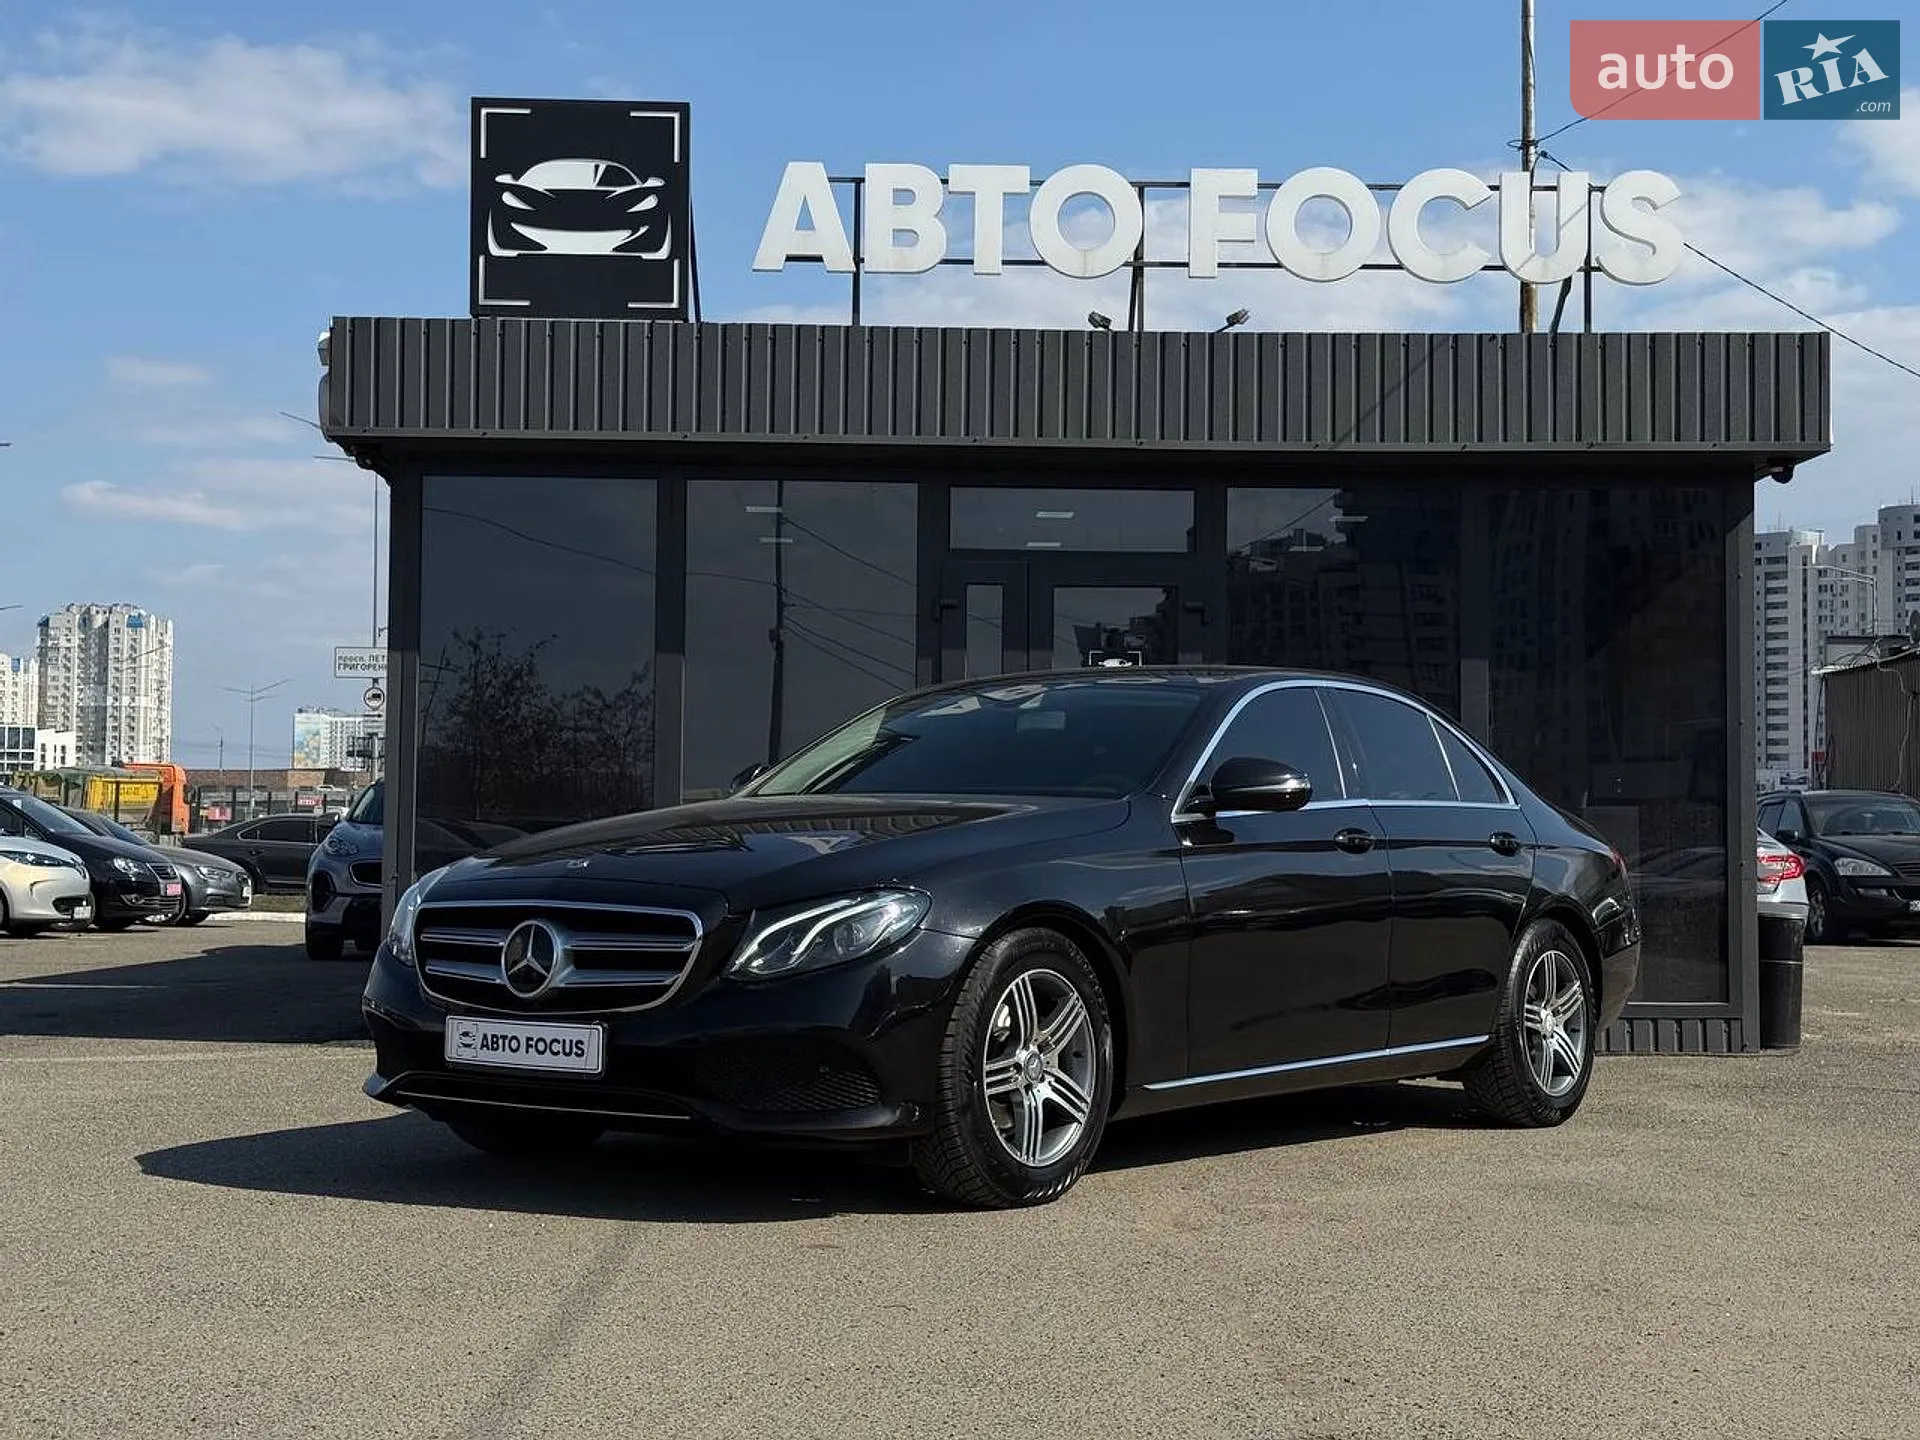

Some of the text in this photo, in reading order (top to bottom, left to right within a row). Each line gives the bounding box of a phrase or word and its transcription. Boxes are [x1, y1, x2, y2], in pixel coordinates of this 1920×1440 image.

[752, 161, 1684, 285] АВТО FOCUS
[480, 1033, 585, 1057] АВТО FOCUS
